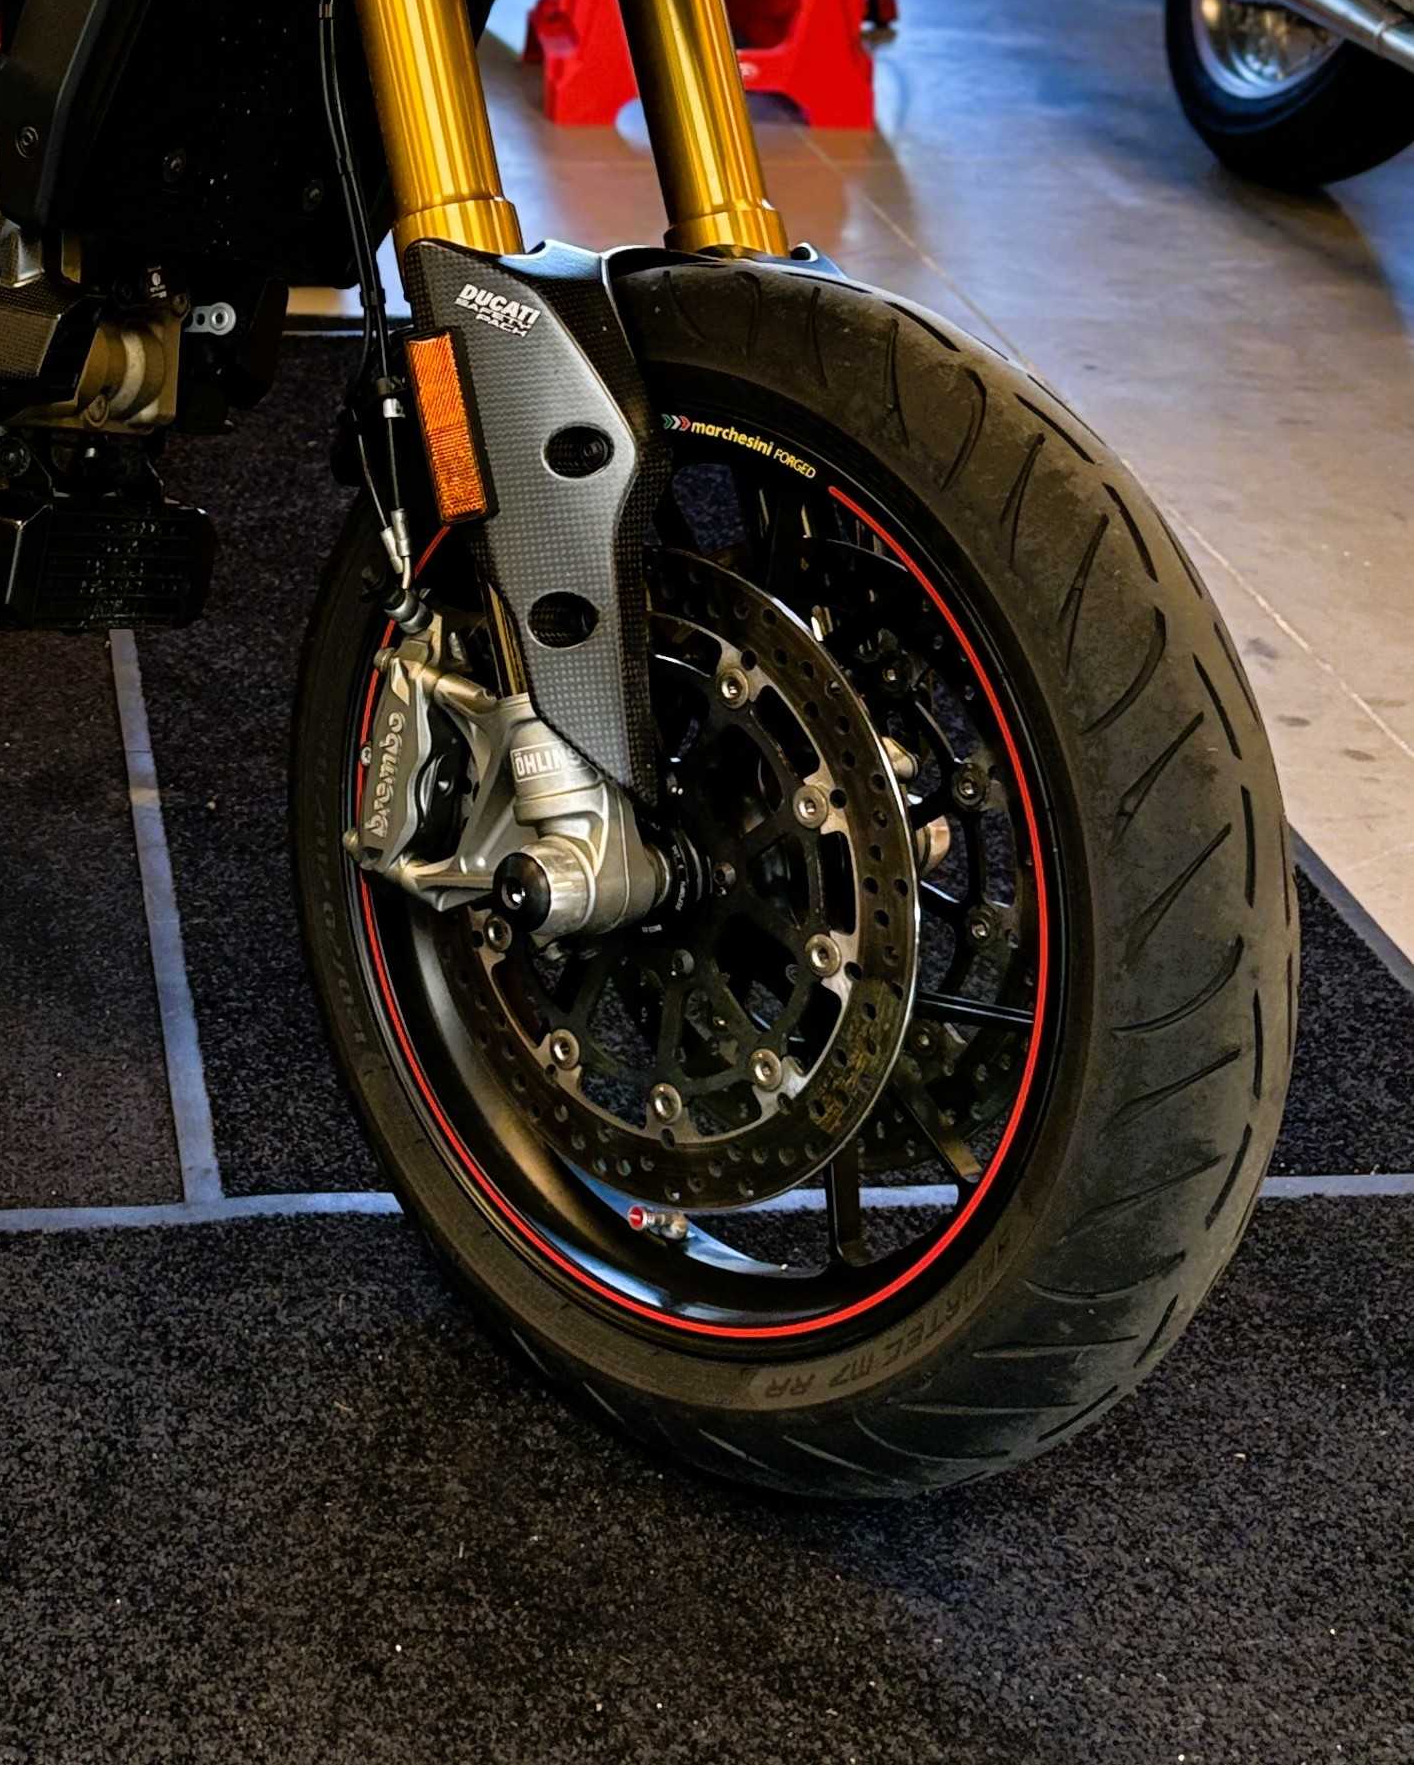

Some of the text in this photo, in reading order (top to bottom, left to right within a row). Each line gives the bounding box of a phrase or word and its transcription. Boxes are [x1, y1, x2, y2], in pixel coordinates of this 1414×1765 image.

[454, 297, 533, 330] SAFETY
[459, 283, 541, 325] DUCATI
[475, 313, 528, 337] PACK
[691, 421, 817, 479] marchesini FORGED
[364, 711, 406, 838] brembo
[764, 1373, 817, 1398] RR
